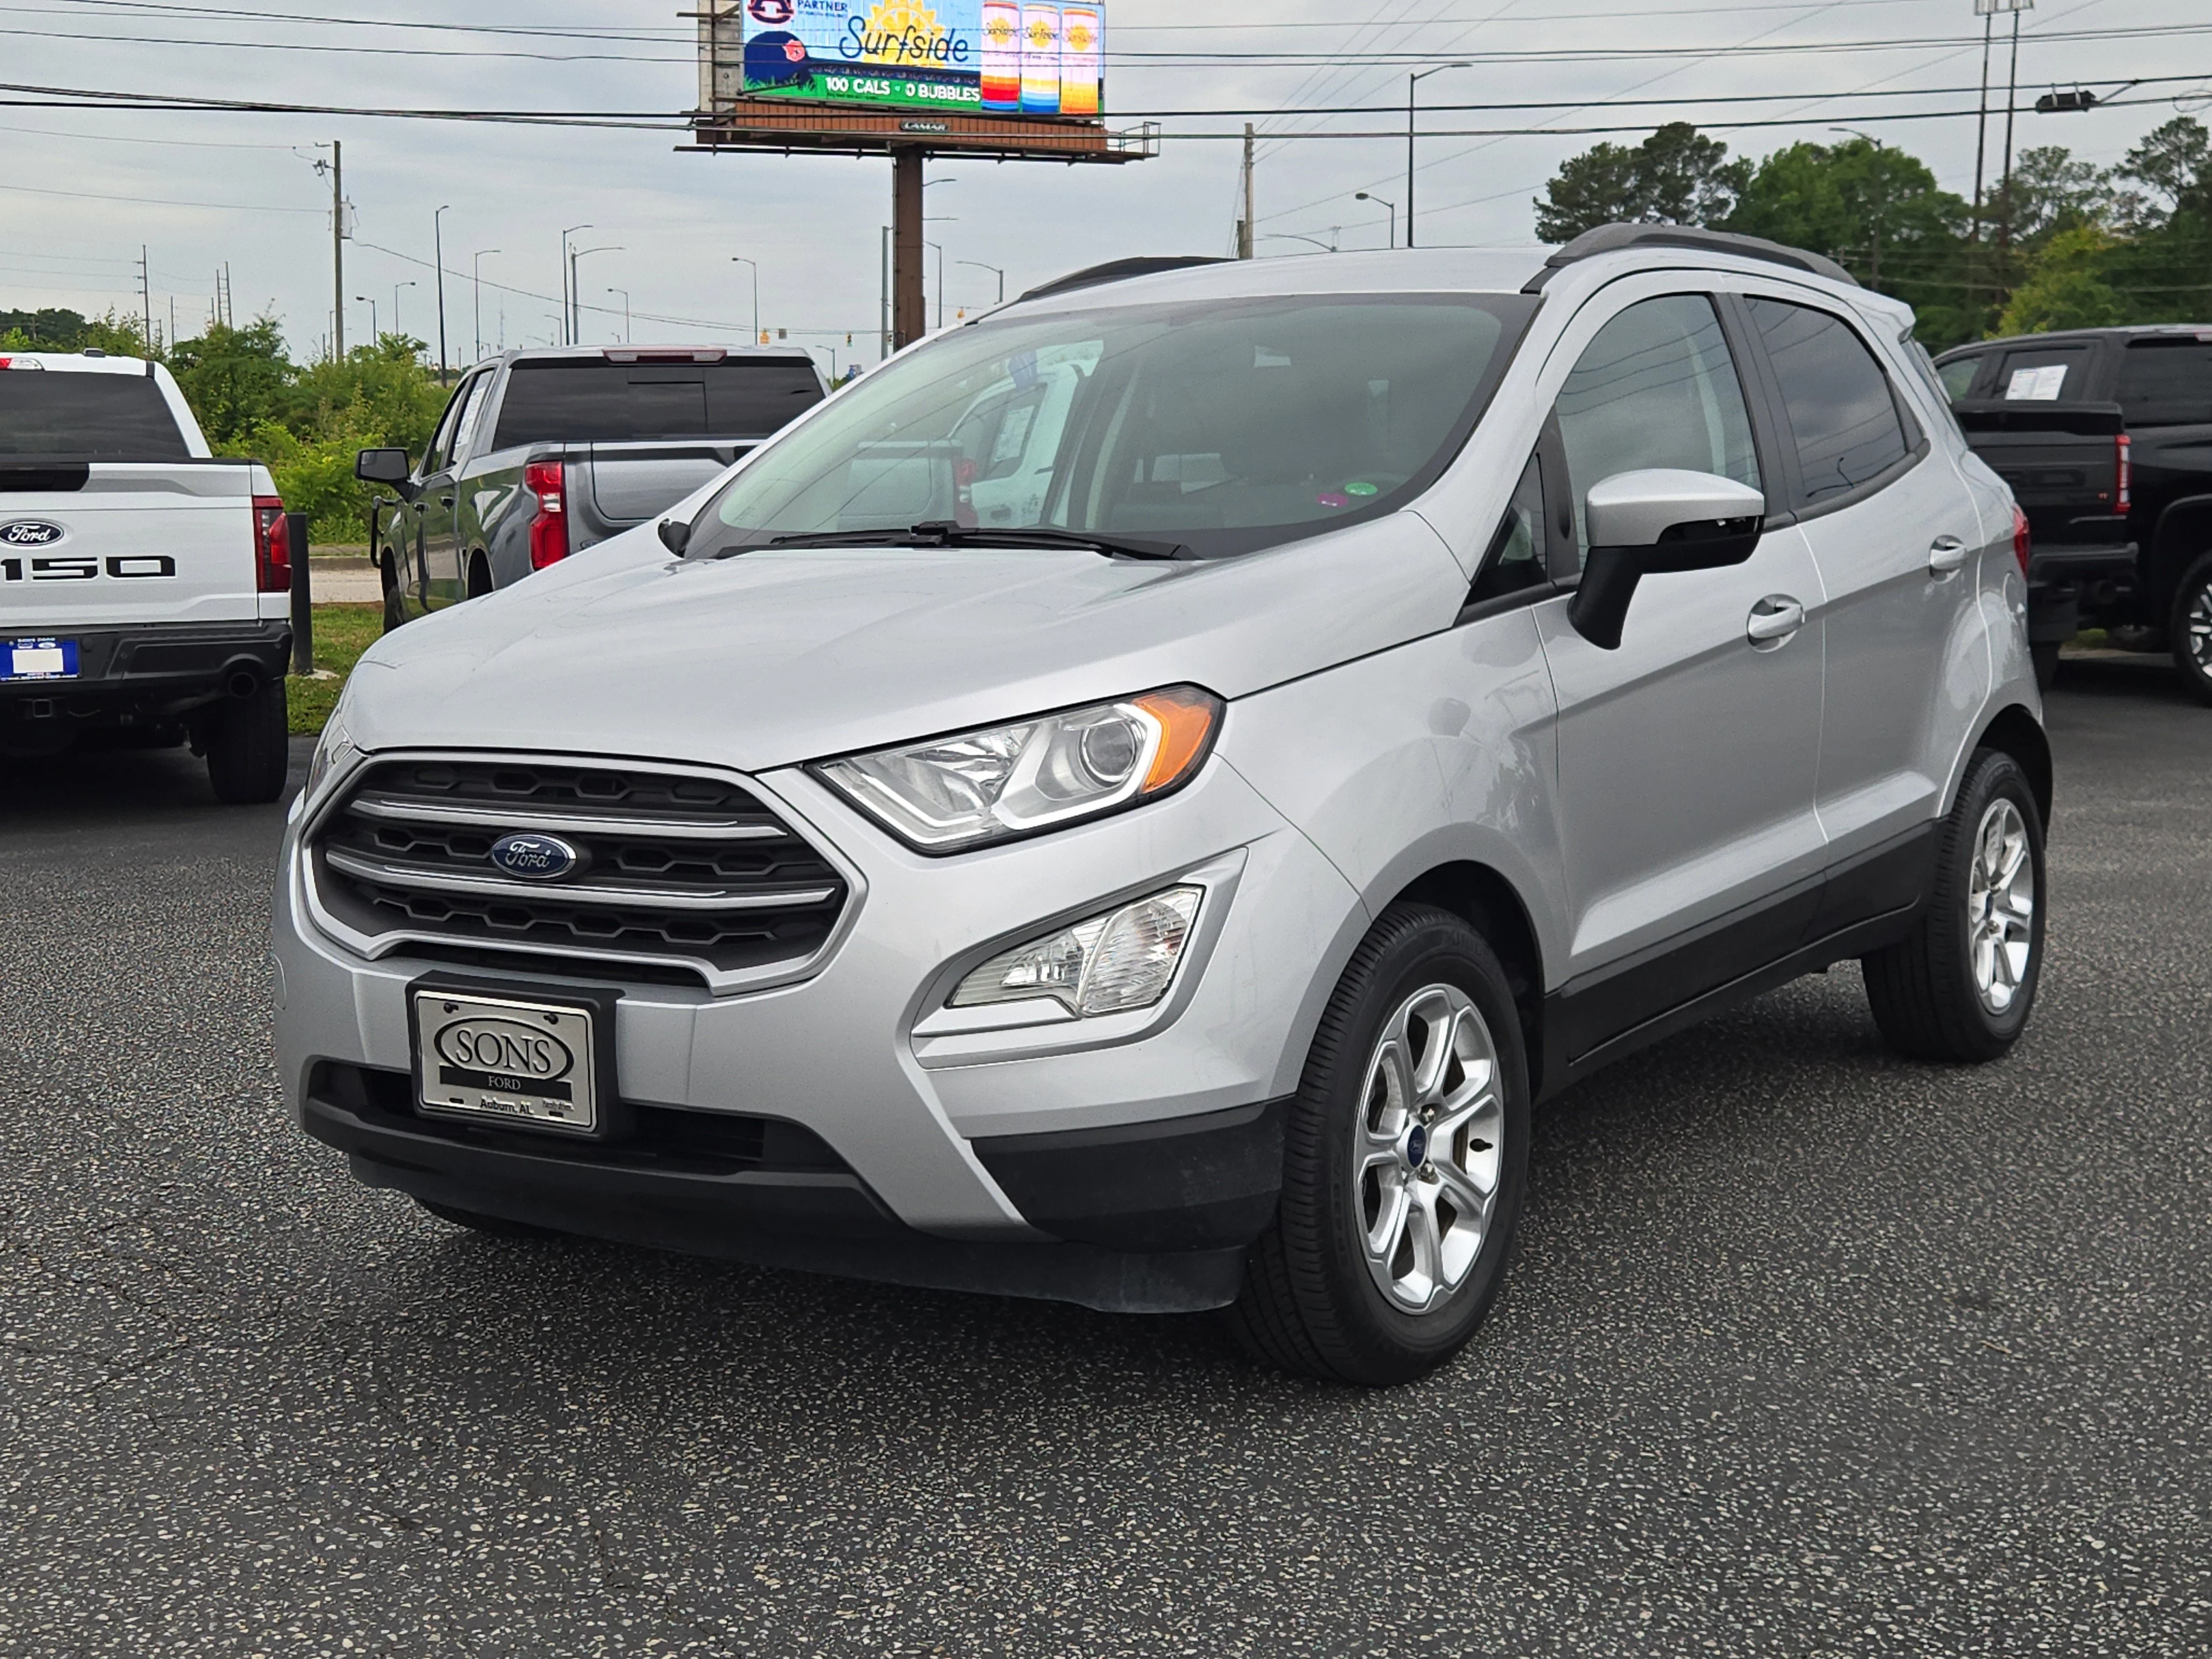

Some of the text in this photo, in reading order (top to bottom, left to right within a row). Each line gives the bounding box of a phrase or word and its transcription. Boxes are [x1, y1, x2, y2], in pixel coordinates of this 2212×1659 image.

[798, 1, 848, 12] PARTNER
[839, 15, 968, 63] Surfside
[825, 77, 848, 92] 100
[852, 79, 891, 95] CALS
[917, 83, 981, 102] BUBBLES
[904, 121, 948, 131] LAMAR
[8, 524, 51, 542] Ford
[505, 840, 551, 867] Ford
[455, 1030, 551, 1073] SONS
[488, 1075, 521, 1091] FORD
[519, 1101, 535, 1115] AL
